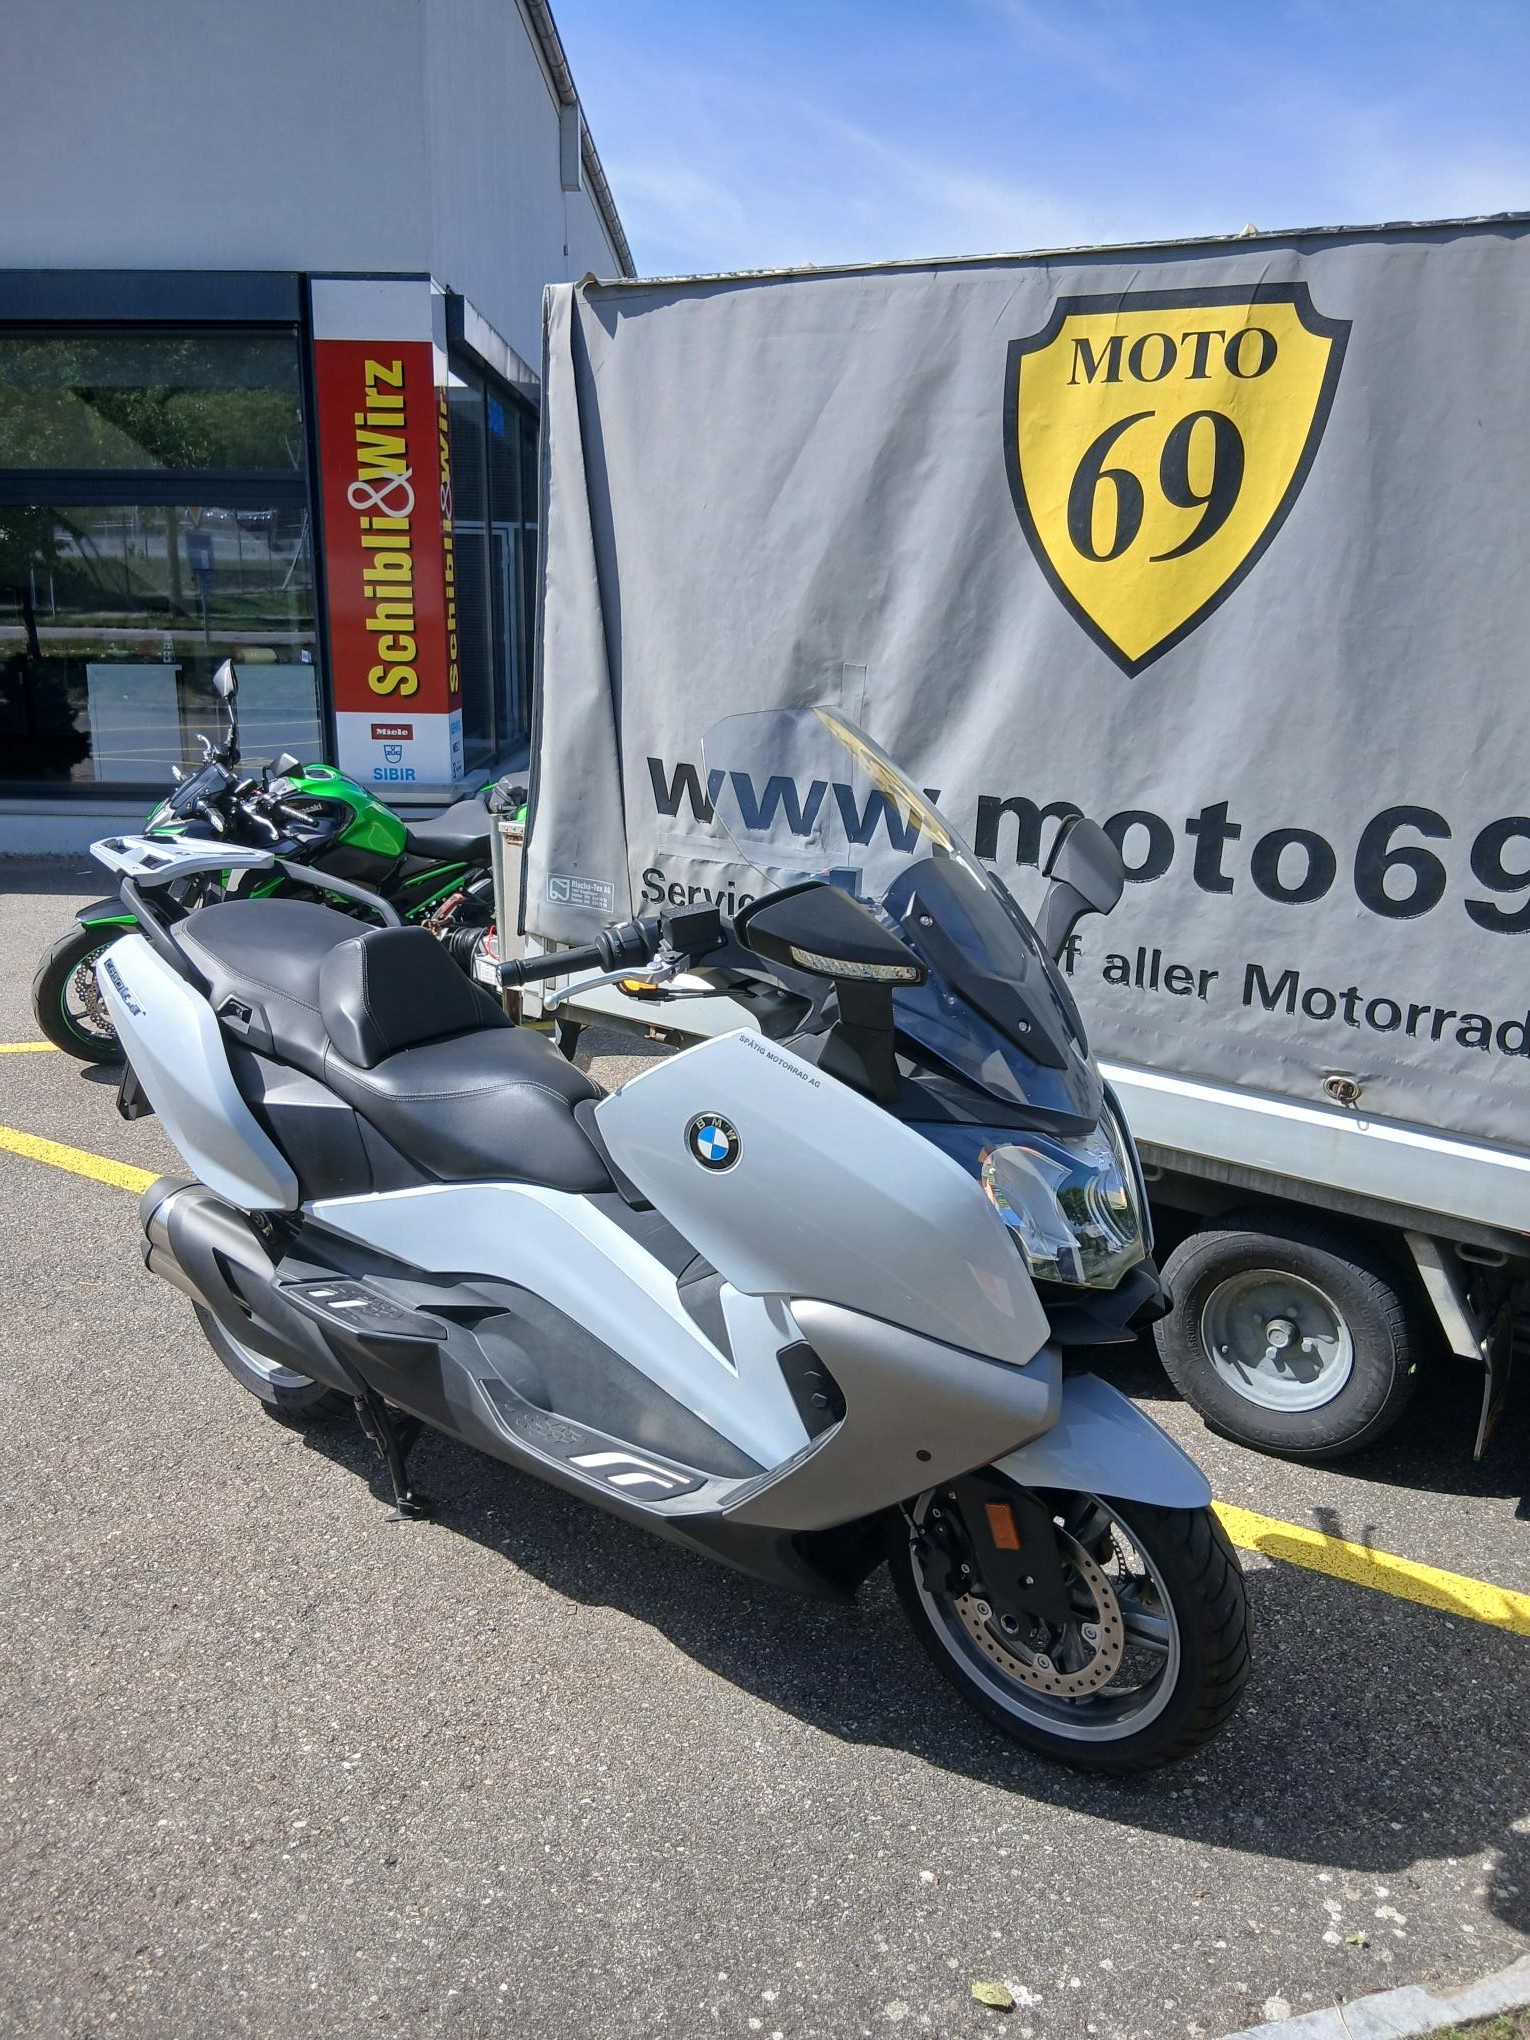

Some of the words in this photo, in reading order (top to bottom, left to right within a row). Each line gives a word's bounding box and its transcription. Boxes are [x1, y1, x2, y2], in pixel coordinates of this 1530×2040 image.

[1066, 326, 1278, 386] MOTO
[1066, 409, 1246, 563] 69
[347, 359, 418, 697] Schibli&Wirz
[373, 767, 415, 780] SIBIR
[1102, 946, 1219, 1001] aller
[766, 1051, 809, 1081] MOTORRAD
[808, 1077, 821, 1088] AG
[696, 1117, 737, 1141] BMW
